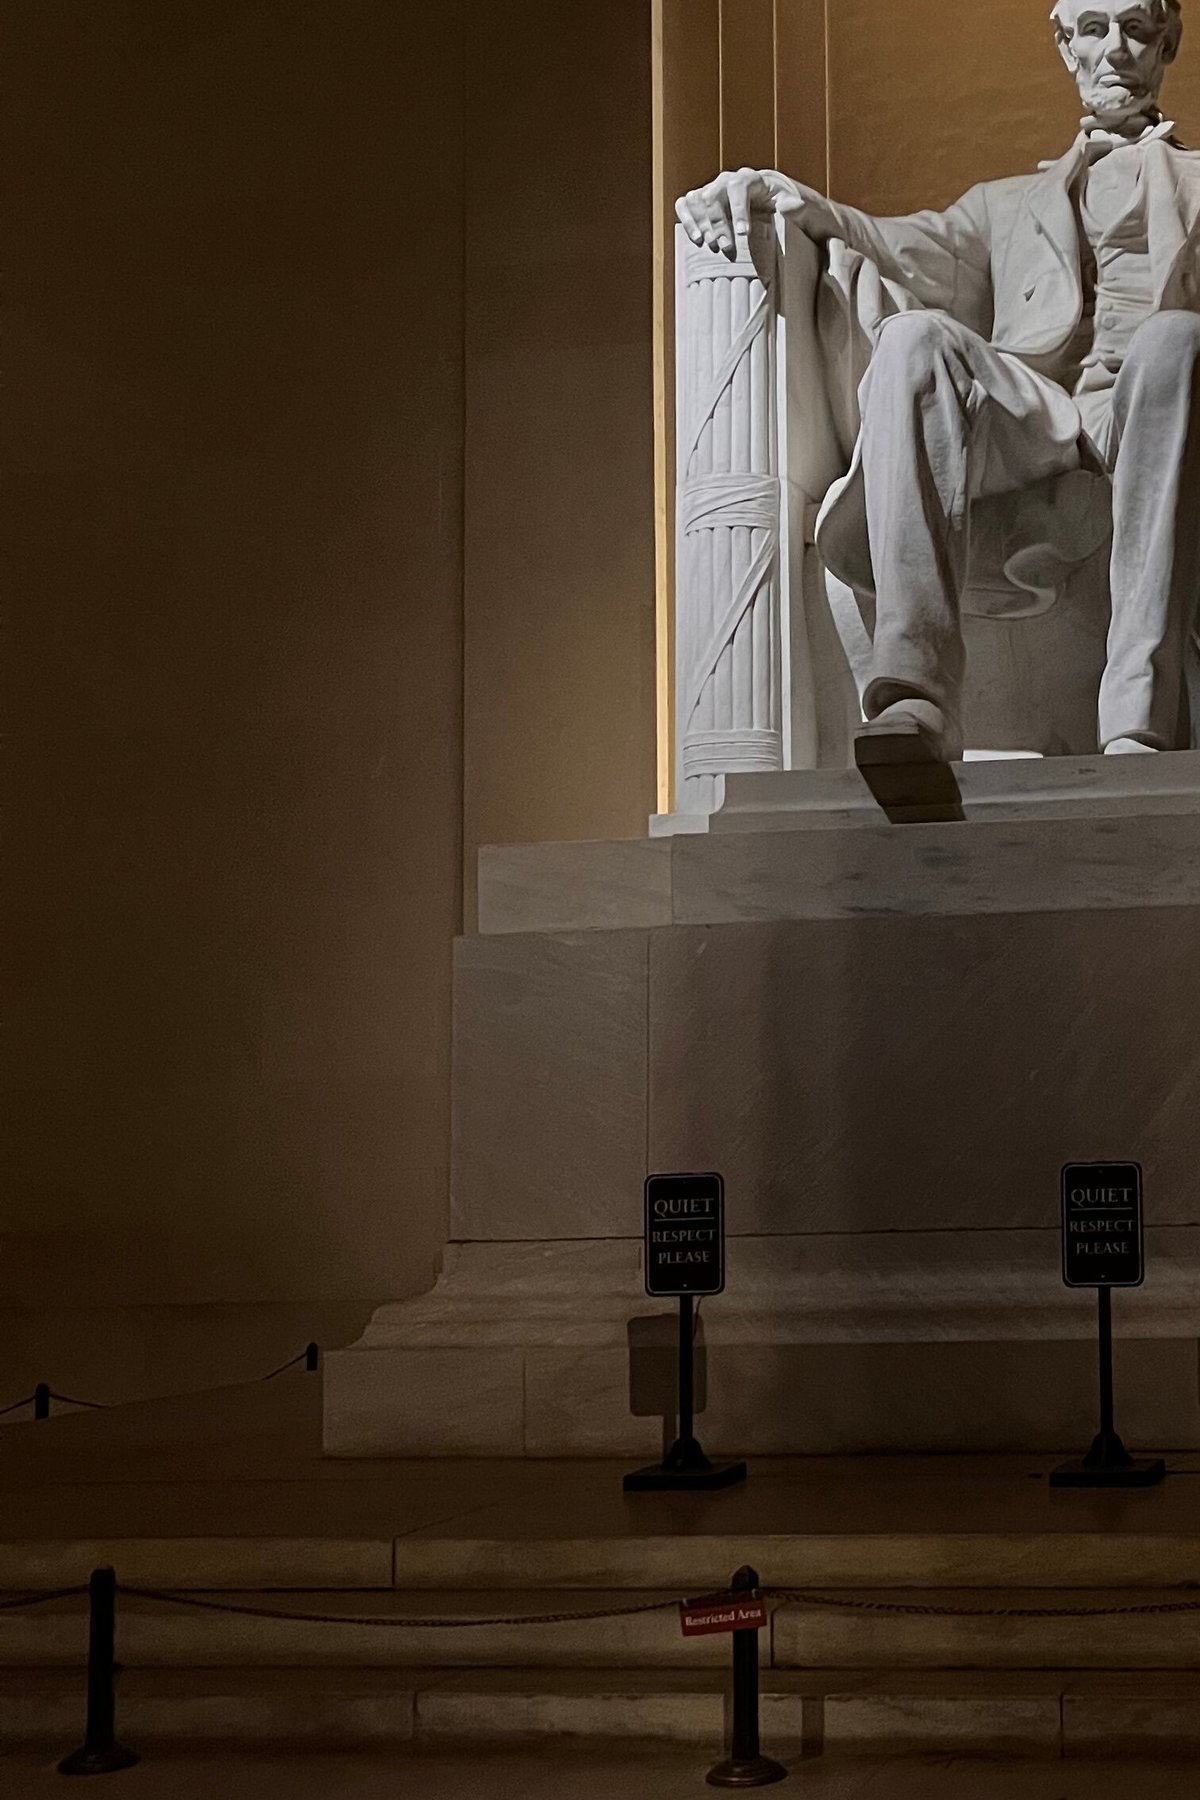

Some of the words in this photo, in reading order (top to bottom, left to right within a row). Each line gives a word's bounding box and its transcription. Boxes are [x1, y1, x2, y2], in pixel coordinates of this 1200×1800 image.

[1071, 1188, 1133, 1206] QUIET
[654, 1198, 714, 1217] QUIET
[1070, 1220, 1135, 1233] RESPECT
[652, 1229, 716, 1243] RESPECT
[1076, 1242, 1130, 1254] PLEASE
[658, 1251, 711, 1264] PLEASE
[685, 1611, 735, 1626] Restricted
[738, 1609, 762, 1620] Area
